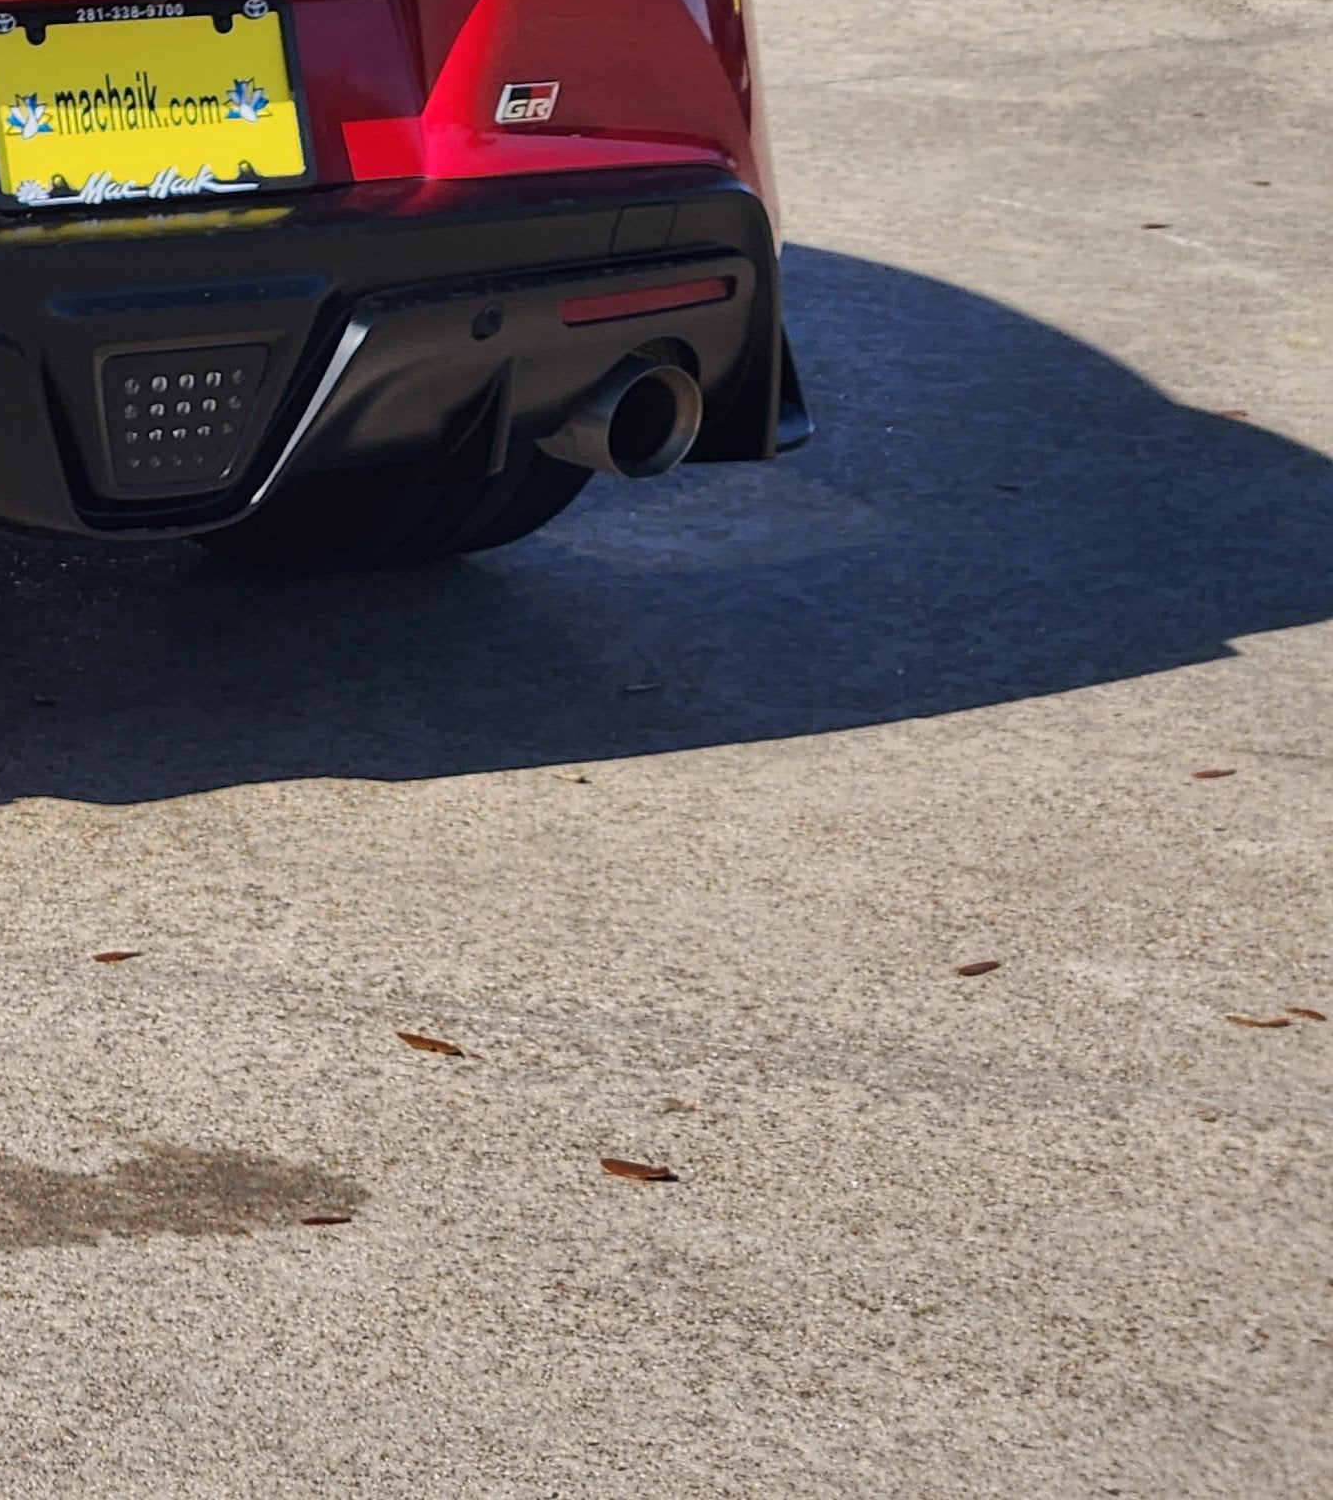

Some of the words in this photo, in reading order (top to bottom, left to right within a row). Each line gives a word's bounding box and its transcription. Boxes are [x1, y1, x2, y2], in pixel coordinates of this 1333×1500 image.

[54, 71, 222, 135] machaik.com
[33, 171, 147, 206] Mac
[148, 164, 260, 199] Haik
